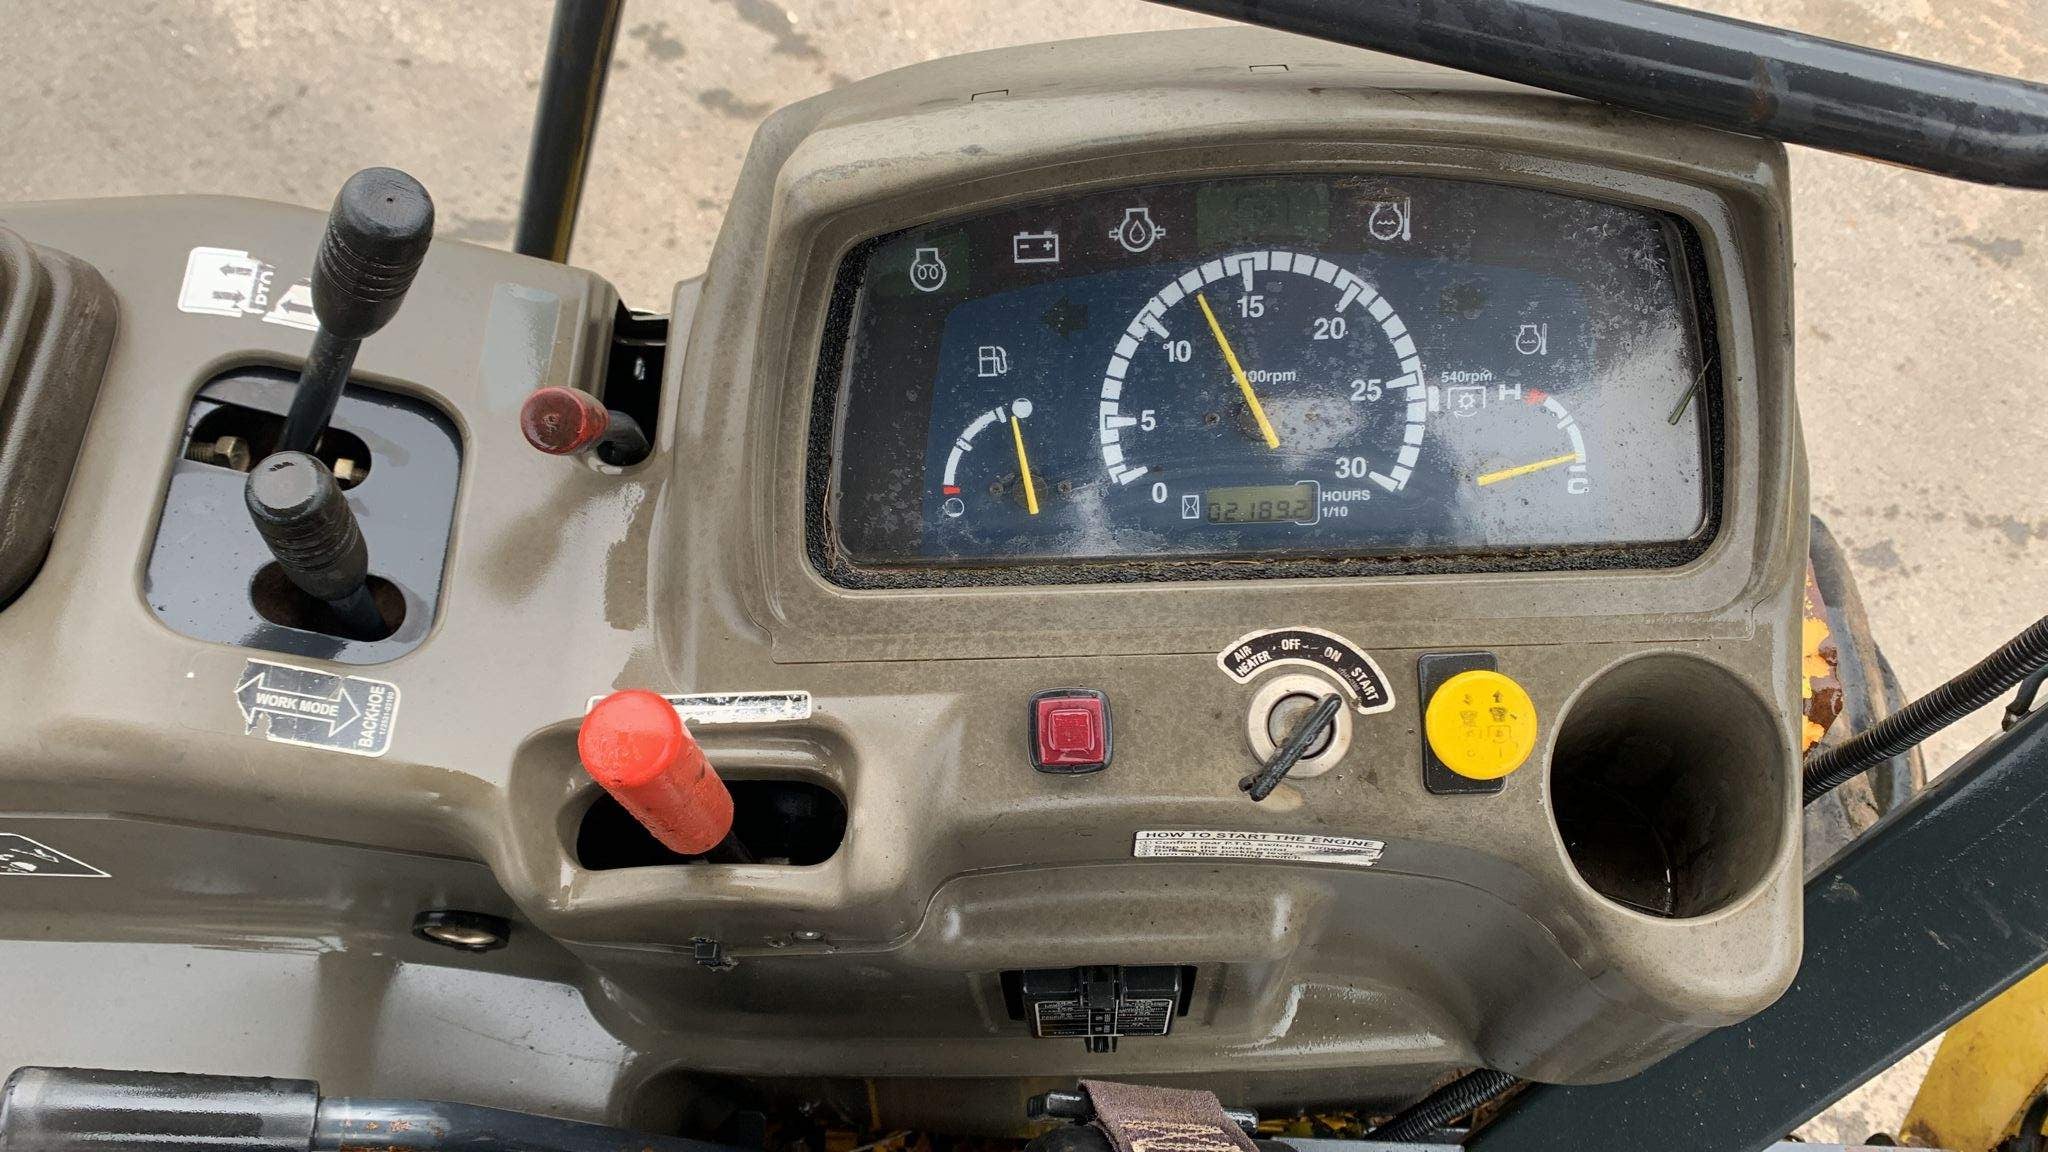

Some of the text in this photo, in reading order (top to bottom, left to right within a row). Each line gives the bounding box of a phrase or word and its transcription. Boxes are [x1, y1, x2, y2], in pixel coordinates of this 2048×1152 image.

[1237, 295, 1265, 318] 15
[1313, 316, 1346, 340] 20
[1166, 340, 1192, 363] 10
[1440, 370, 1493, 383] 540rpm
[1350, 378, 1383, 401] 25
[1499, 383, 1522, 400] H
[1140, 409, 1157, 432] 5
[1334, 456, 1367, 479] 30
[1151, 482, 1168, 503] 0
[1321, 490, 1371, 501] HOURS
[1567, 477, 1590, 495] C
[1321, 506, 1349, 518] 1/10
[1233, 645, 1253, 663] AIR
[1281, 639, 1301, 651] OFF
[1323, 647, 1343, 662] ON
[1235, 650, 1272, 677] HEATER
[1350, 666, 1379, 701] START
[256, 692, 340, 717] WORK MODE
[358, 685, 386, 748] BACKHOE
[1275, 834, 1307, 842] THE
[1311, 837, 1375, 848] ENGINE
